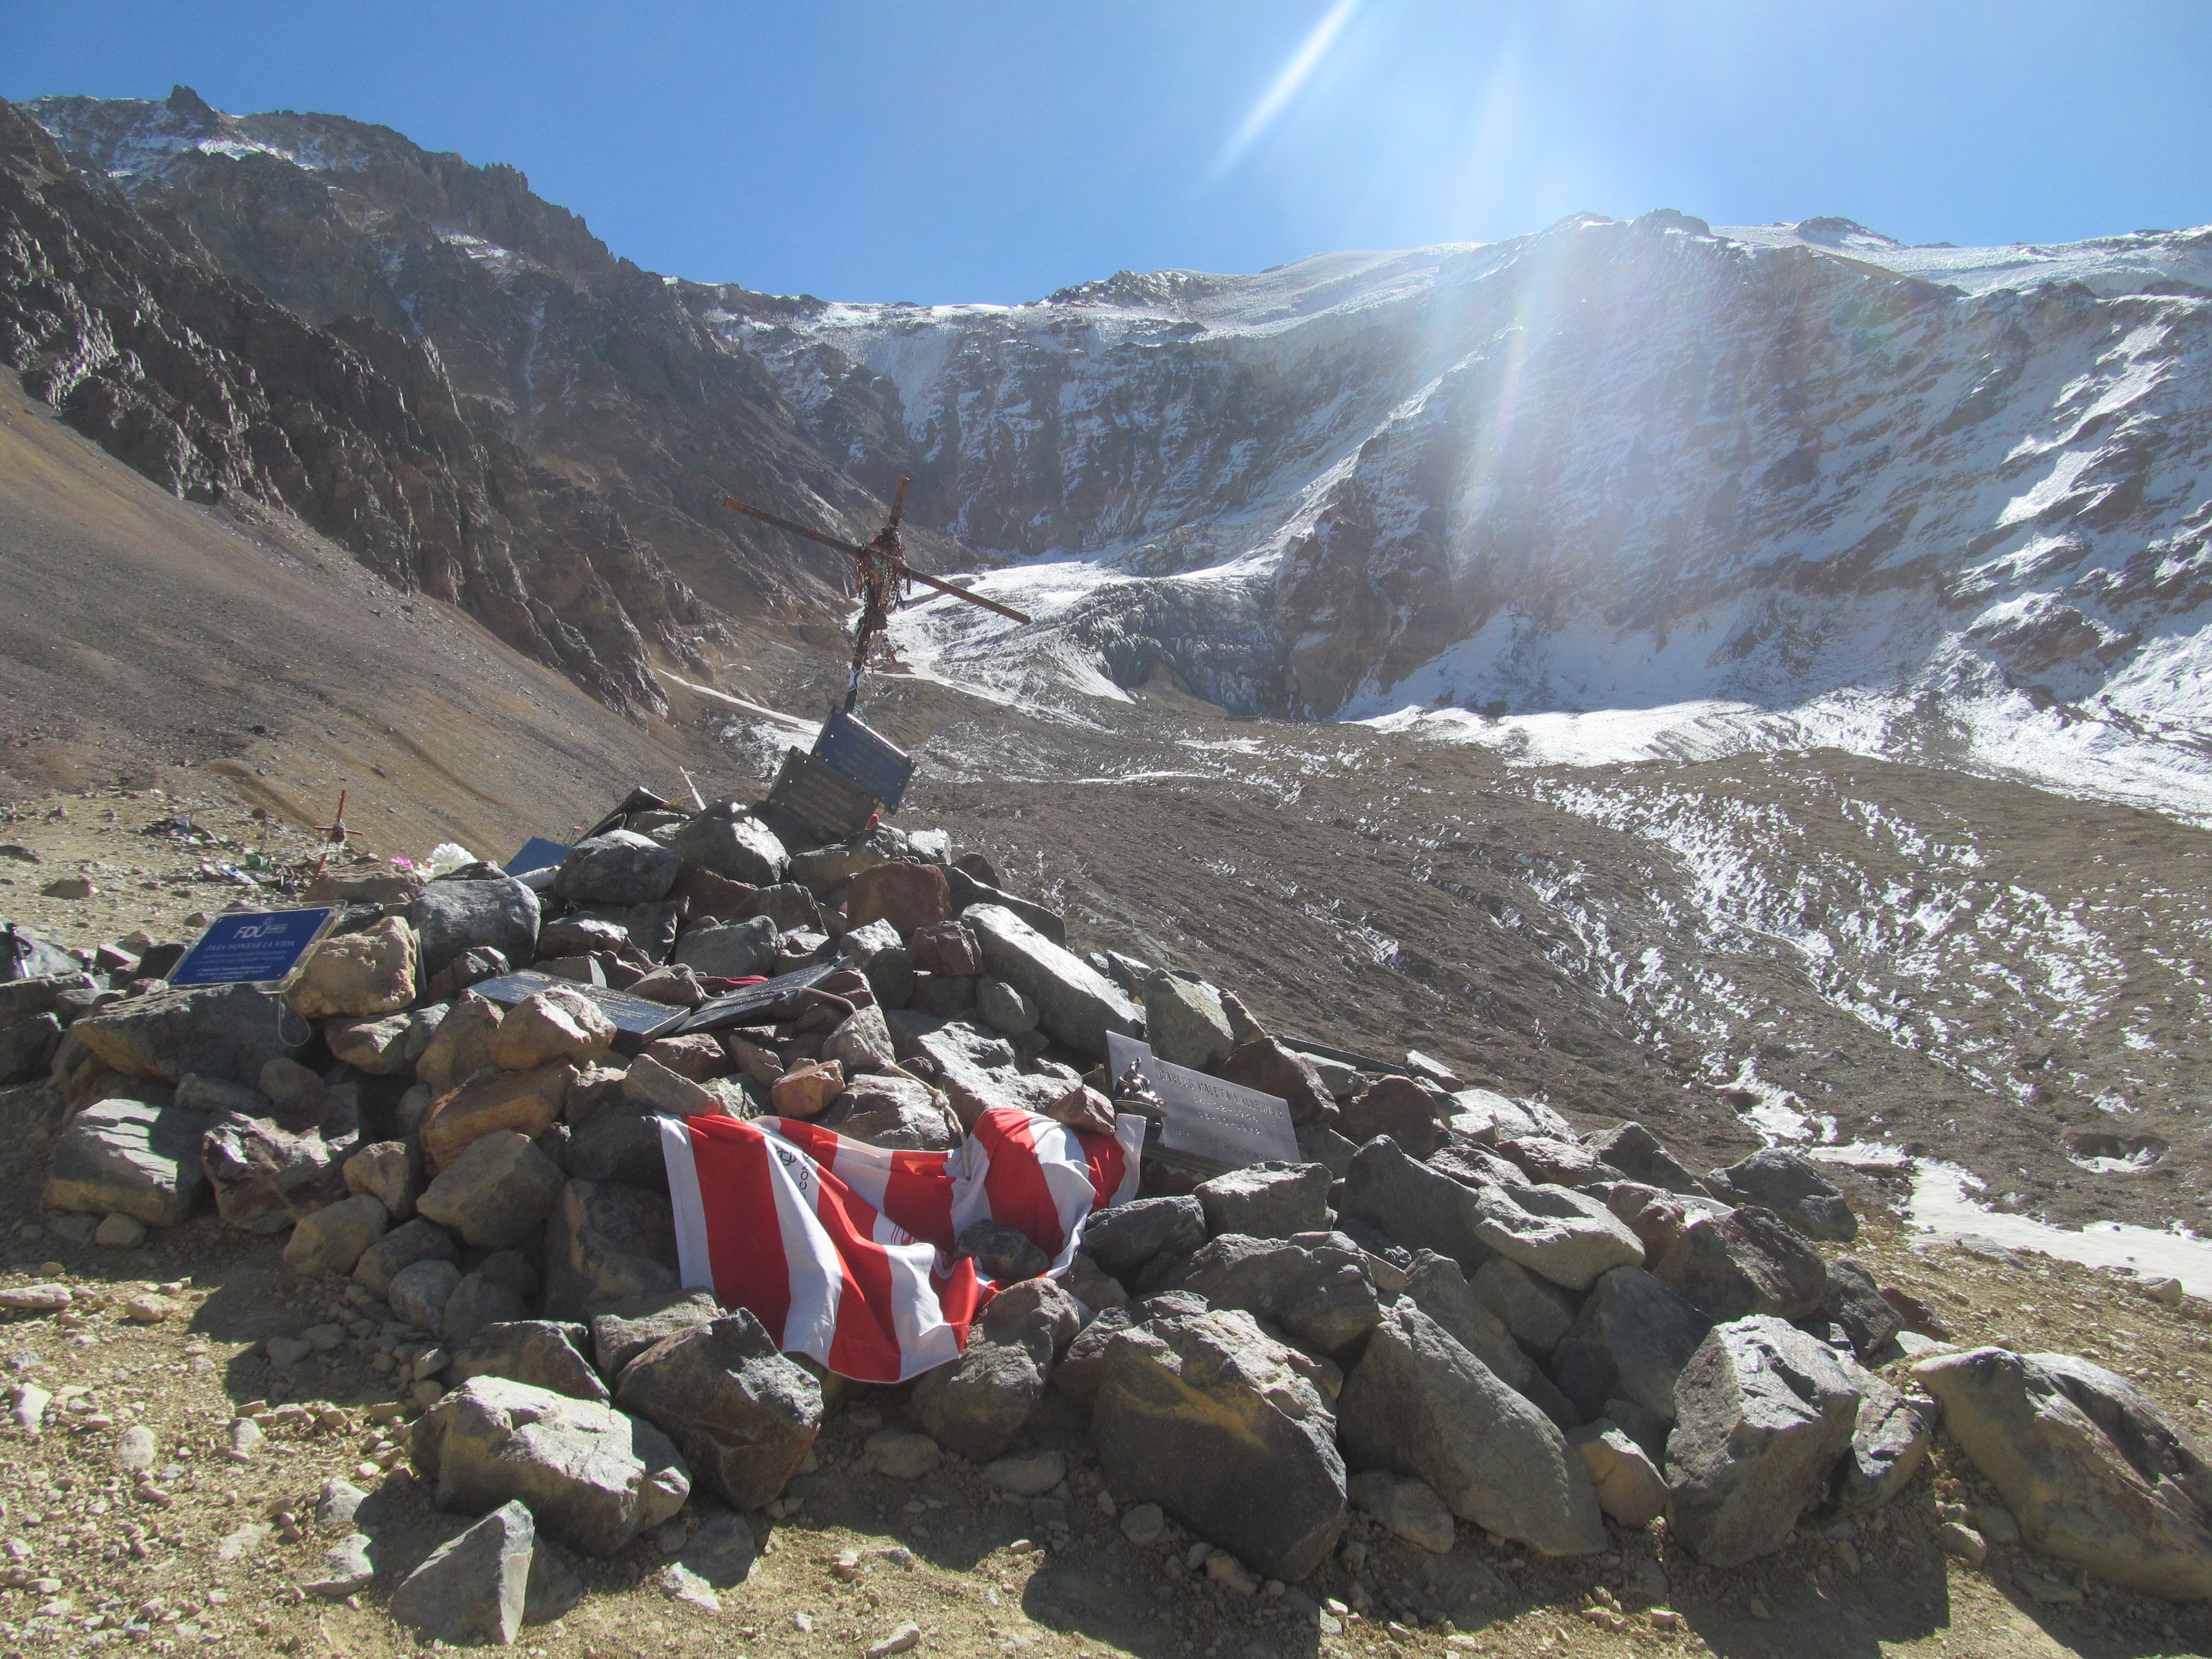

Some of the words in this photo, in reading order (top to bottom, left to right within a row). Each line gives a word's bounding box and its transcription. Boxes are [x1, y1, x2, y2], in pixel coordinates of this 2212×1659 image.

[232, 925, 270, 939] FDU
[1158, 1070, 1195, 1090] CARLOS
[1197, 1081, 1231, 1102] VALETA
